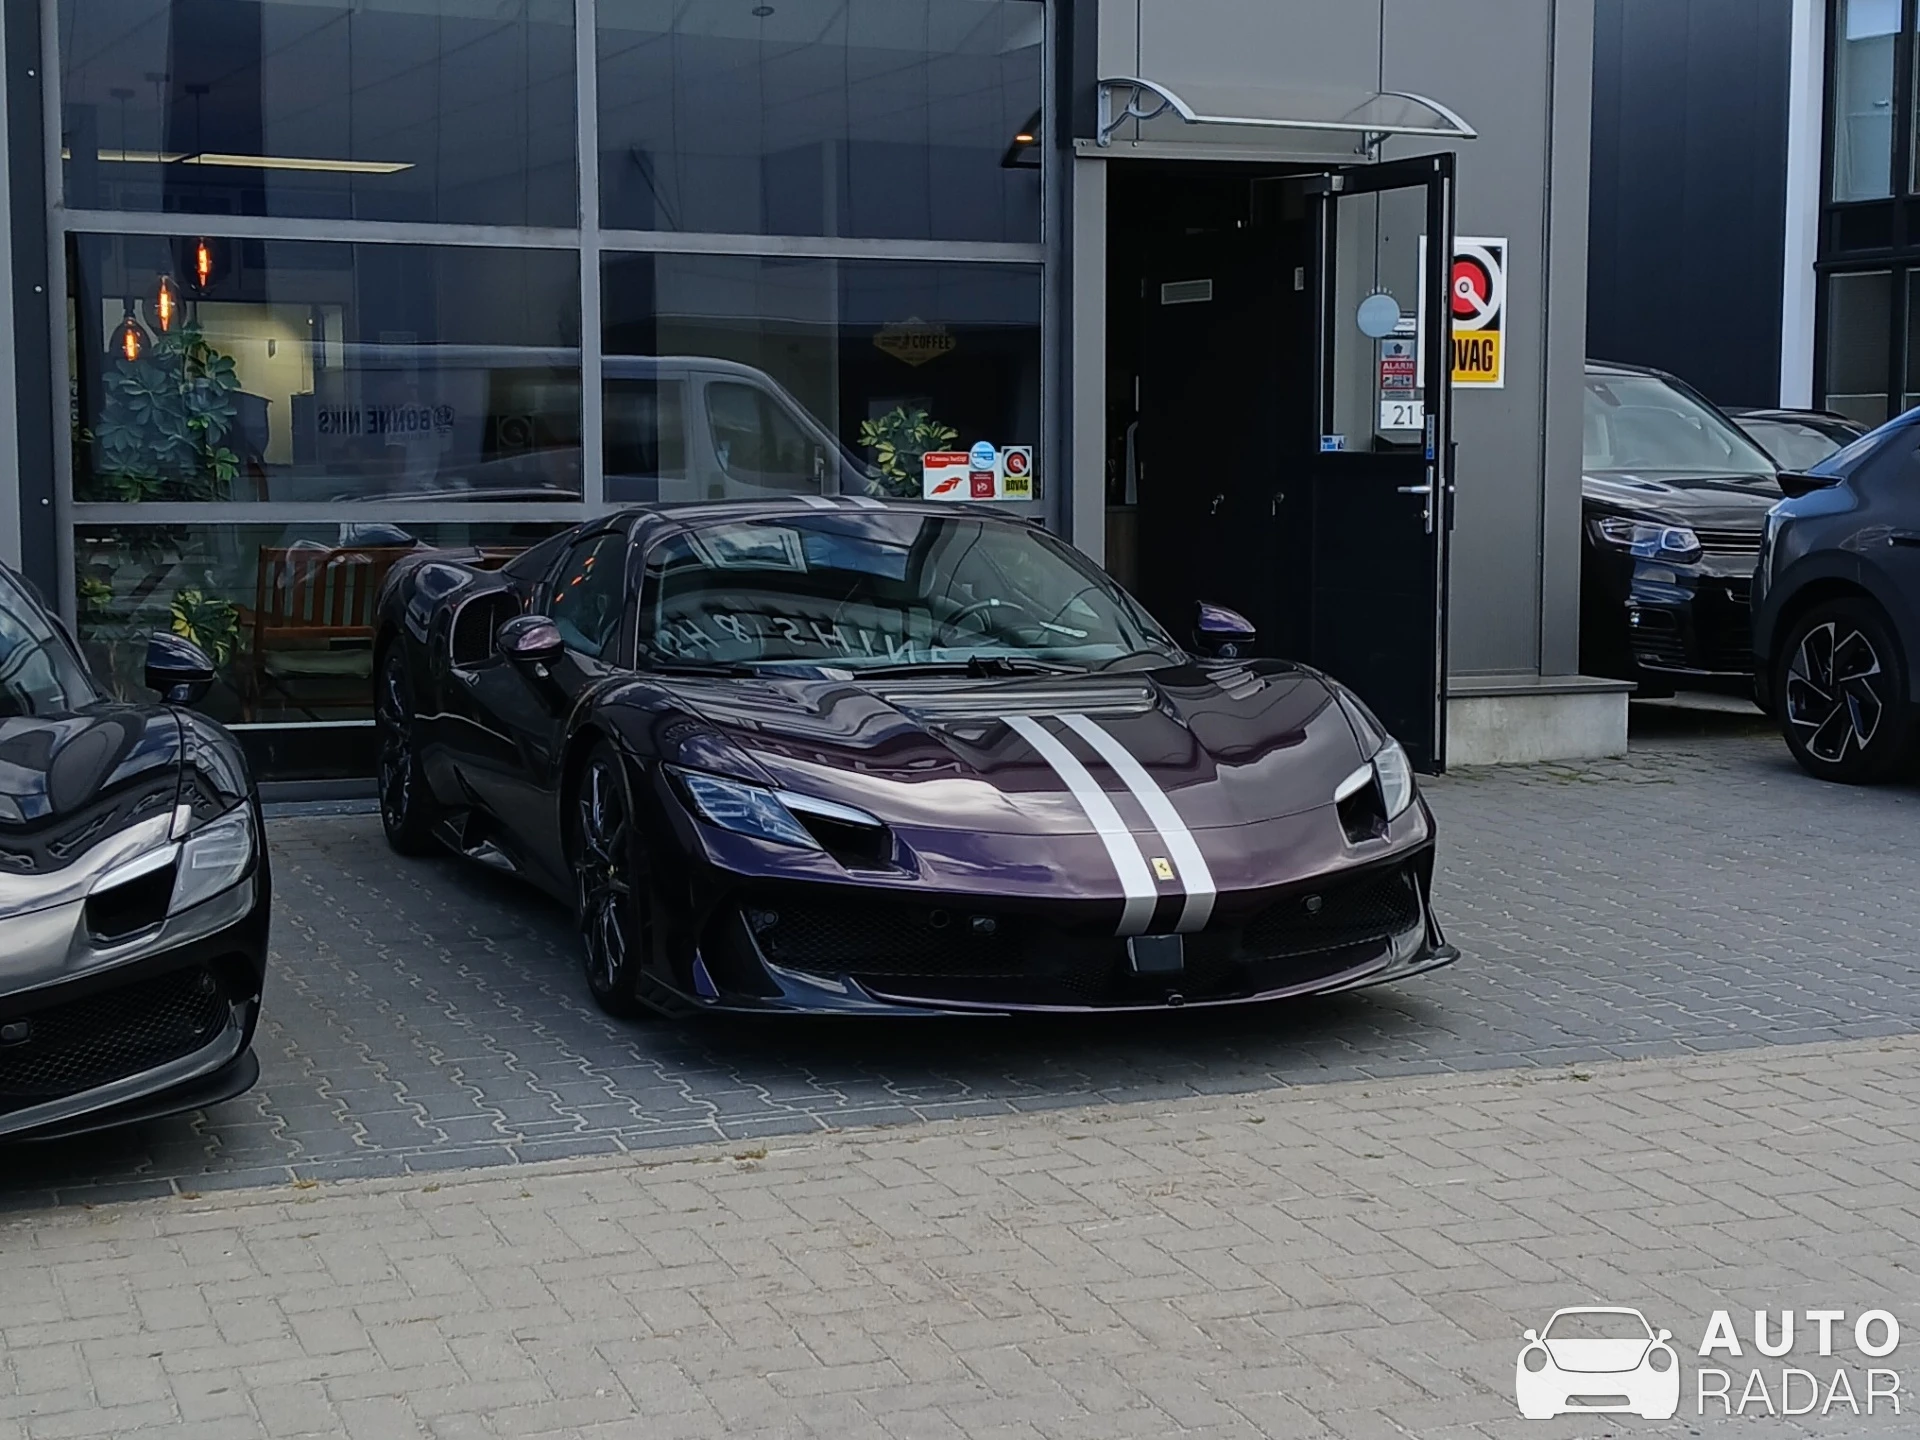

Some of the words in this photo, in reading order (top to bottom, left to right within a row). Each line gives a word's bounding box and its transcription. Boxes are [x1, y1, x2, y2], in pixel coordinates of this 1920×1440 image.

[911, 334, 951, 350] COFFEE
[1451, 338, 1494, 372] VAG
[1382, 361, 1414, 371] ALARM
